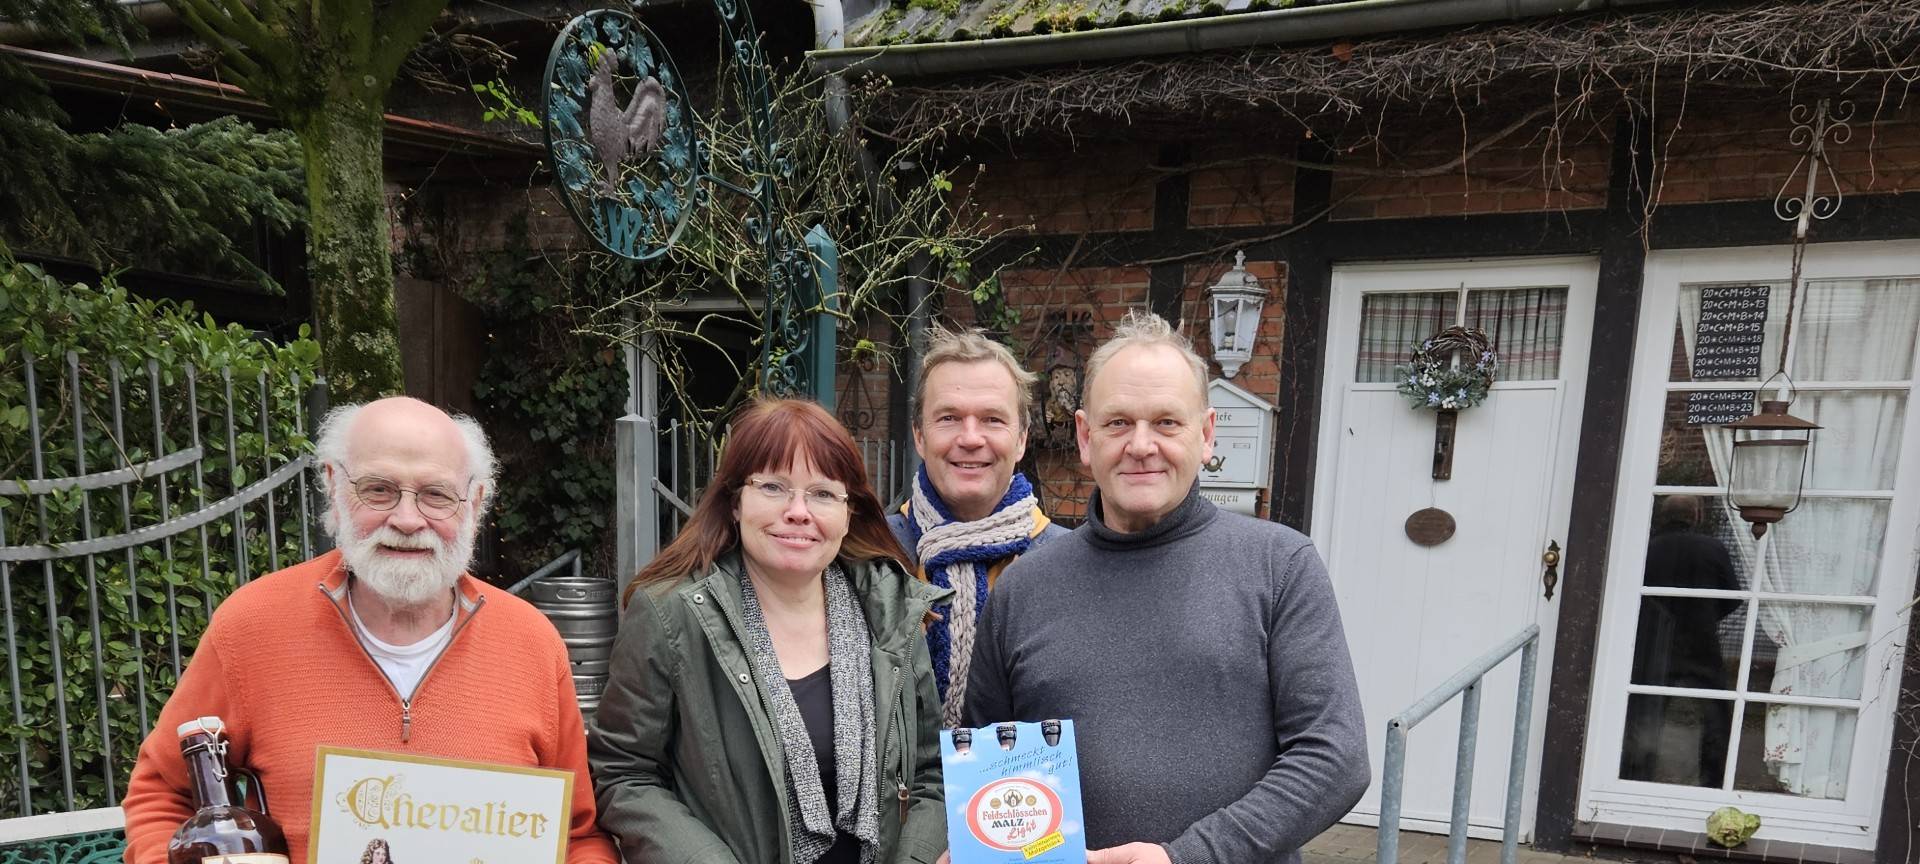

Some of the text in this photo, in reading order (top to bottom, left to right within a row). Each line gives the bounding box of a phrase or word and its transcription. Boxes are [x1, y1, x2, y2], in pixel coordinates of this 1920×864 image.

[342, 774, 549, 840] Chevalier
[982, 807, 1048, 821] Feldschlösschen
[991, 818, 1025, 829] MALZ
